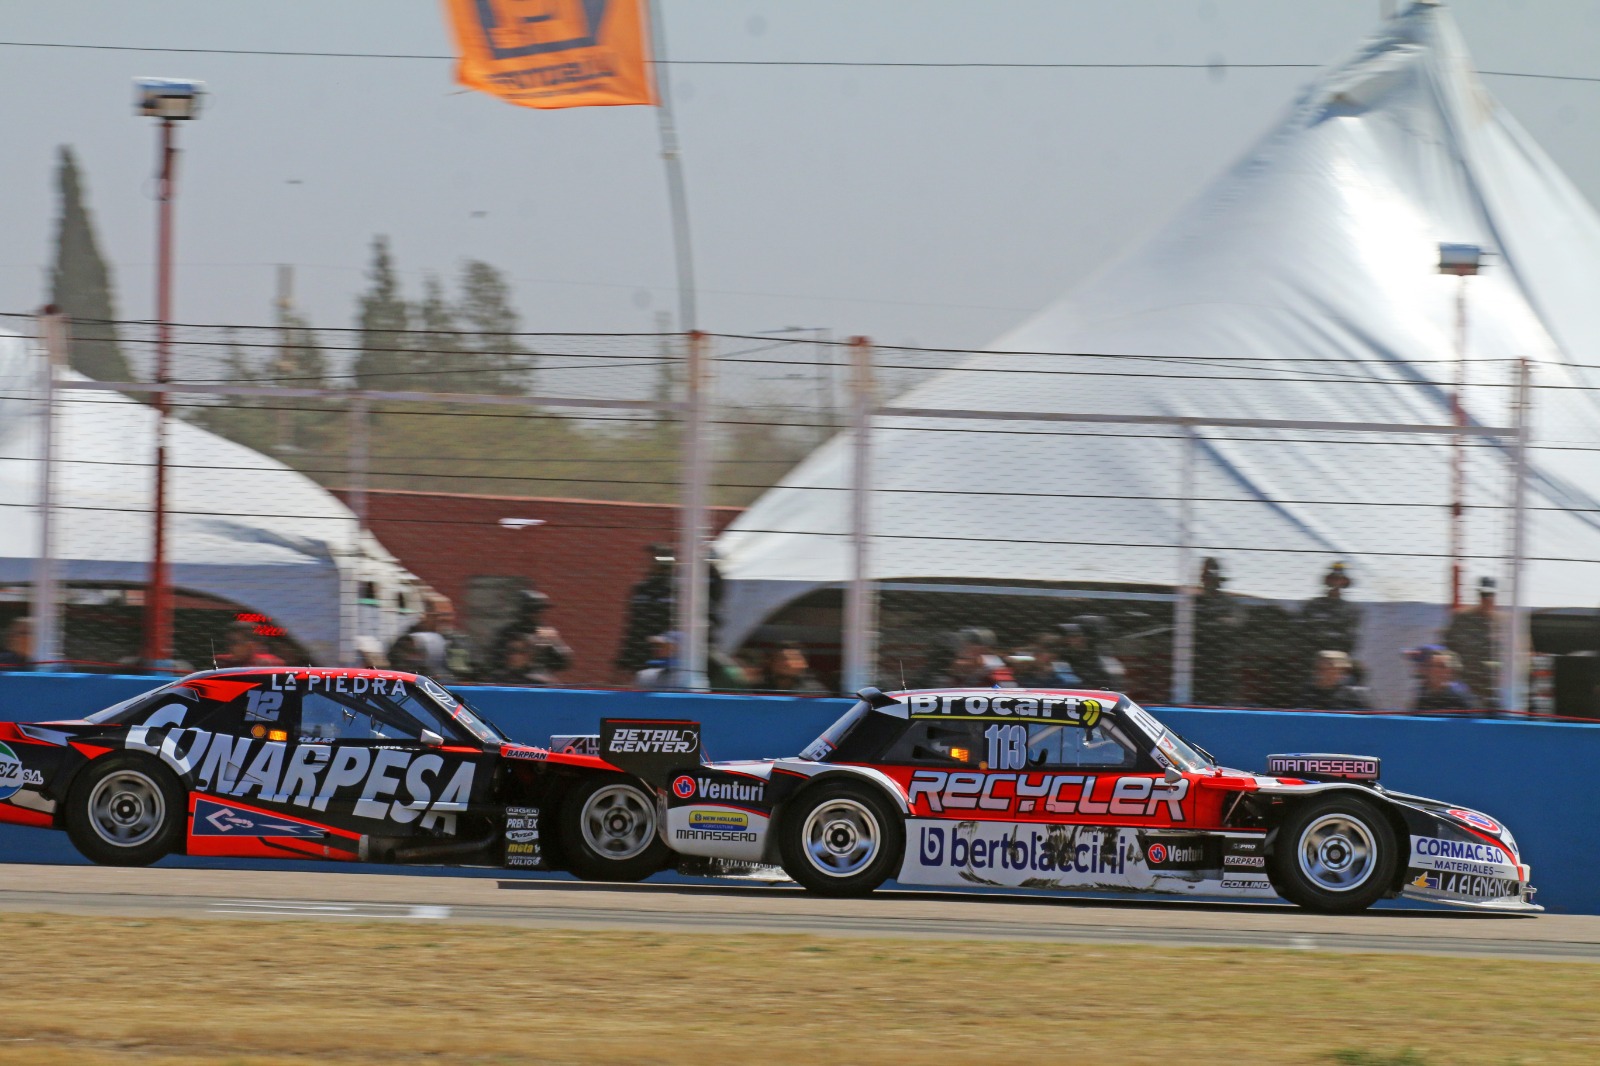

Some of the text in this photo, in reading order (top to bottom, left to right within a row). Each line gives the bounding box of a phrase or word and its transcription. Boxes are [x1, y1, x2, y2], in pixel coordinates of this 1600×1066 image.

[272, 673, 407, 696] LA PIEDRA
[245, 690, 284, 721] 12
[911, 695, 1081, 719] Brocart
[613, 729, 683, 741] DETAIL
[609, 740, 690, 753] CENTER
[984, 724, 1027, 770] 113
[507, 750, 547, 760] BARPRAN
[124, 703, 476, 835] CONARPESA
[1272, 760, 1376, 773] MANASSERO
[697, 777, 764, 801] Venturi
[676, 830, 757, 842] MANASSERO
[1416, 838, 1503, 864] CORMAC 5.0
[1225, 857, 1264, 865] BARPRAN
[1434, 860, 1494, 875] MATERIALES
[1221, 881, 1271, 889] COLLINO
